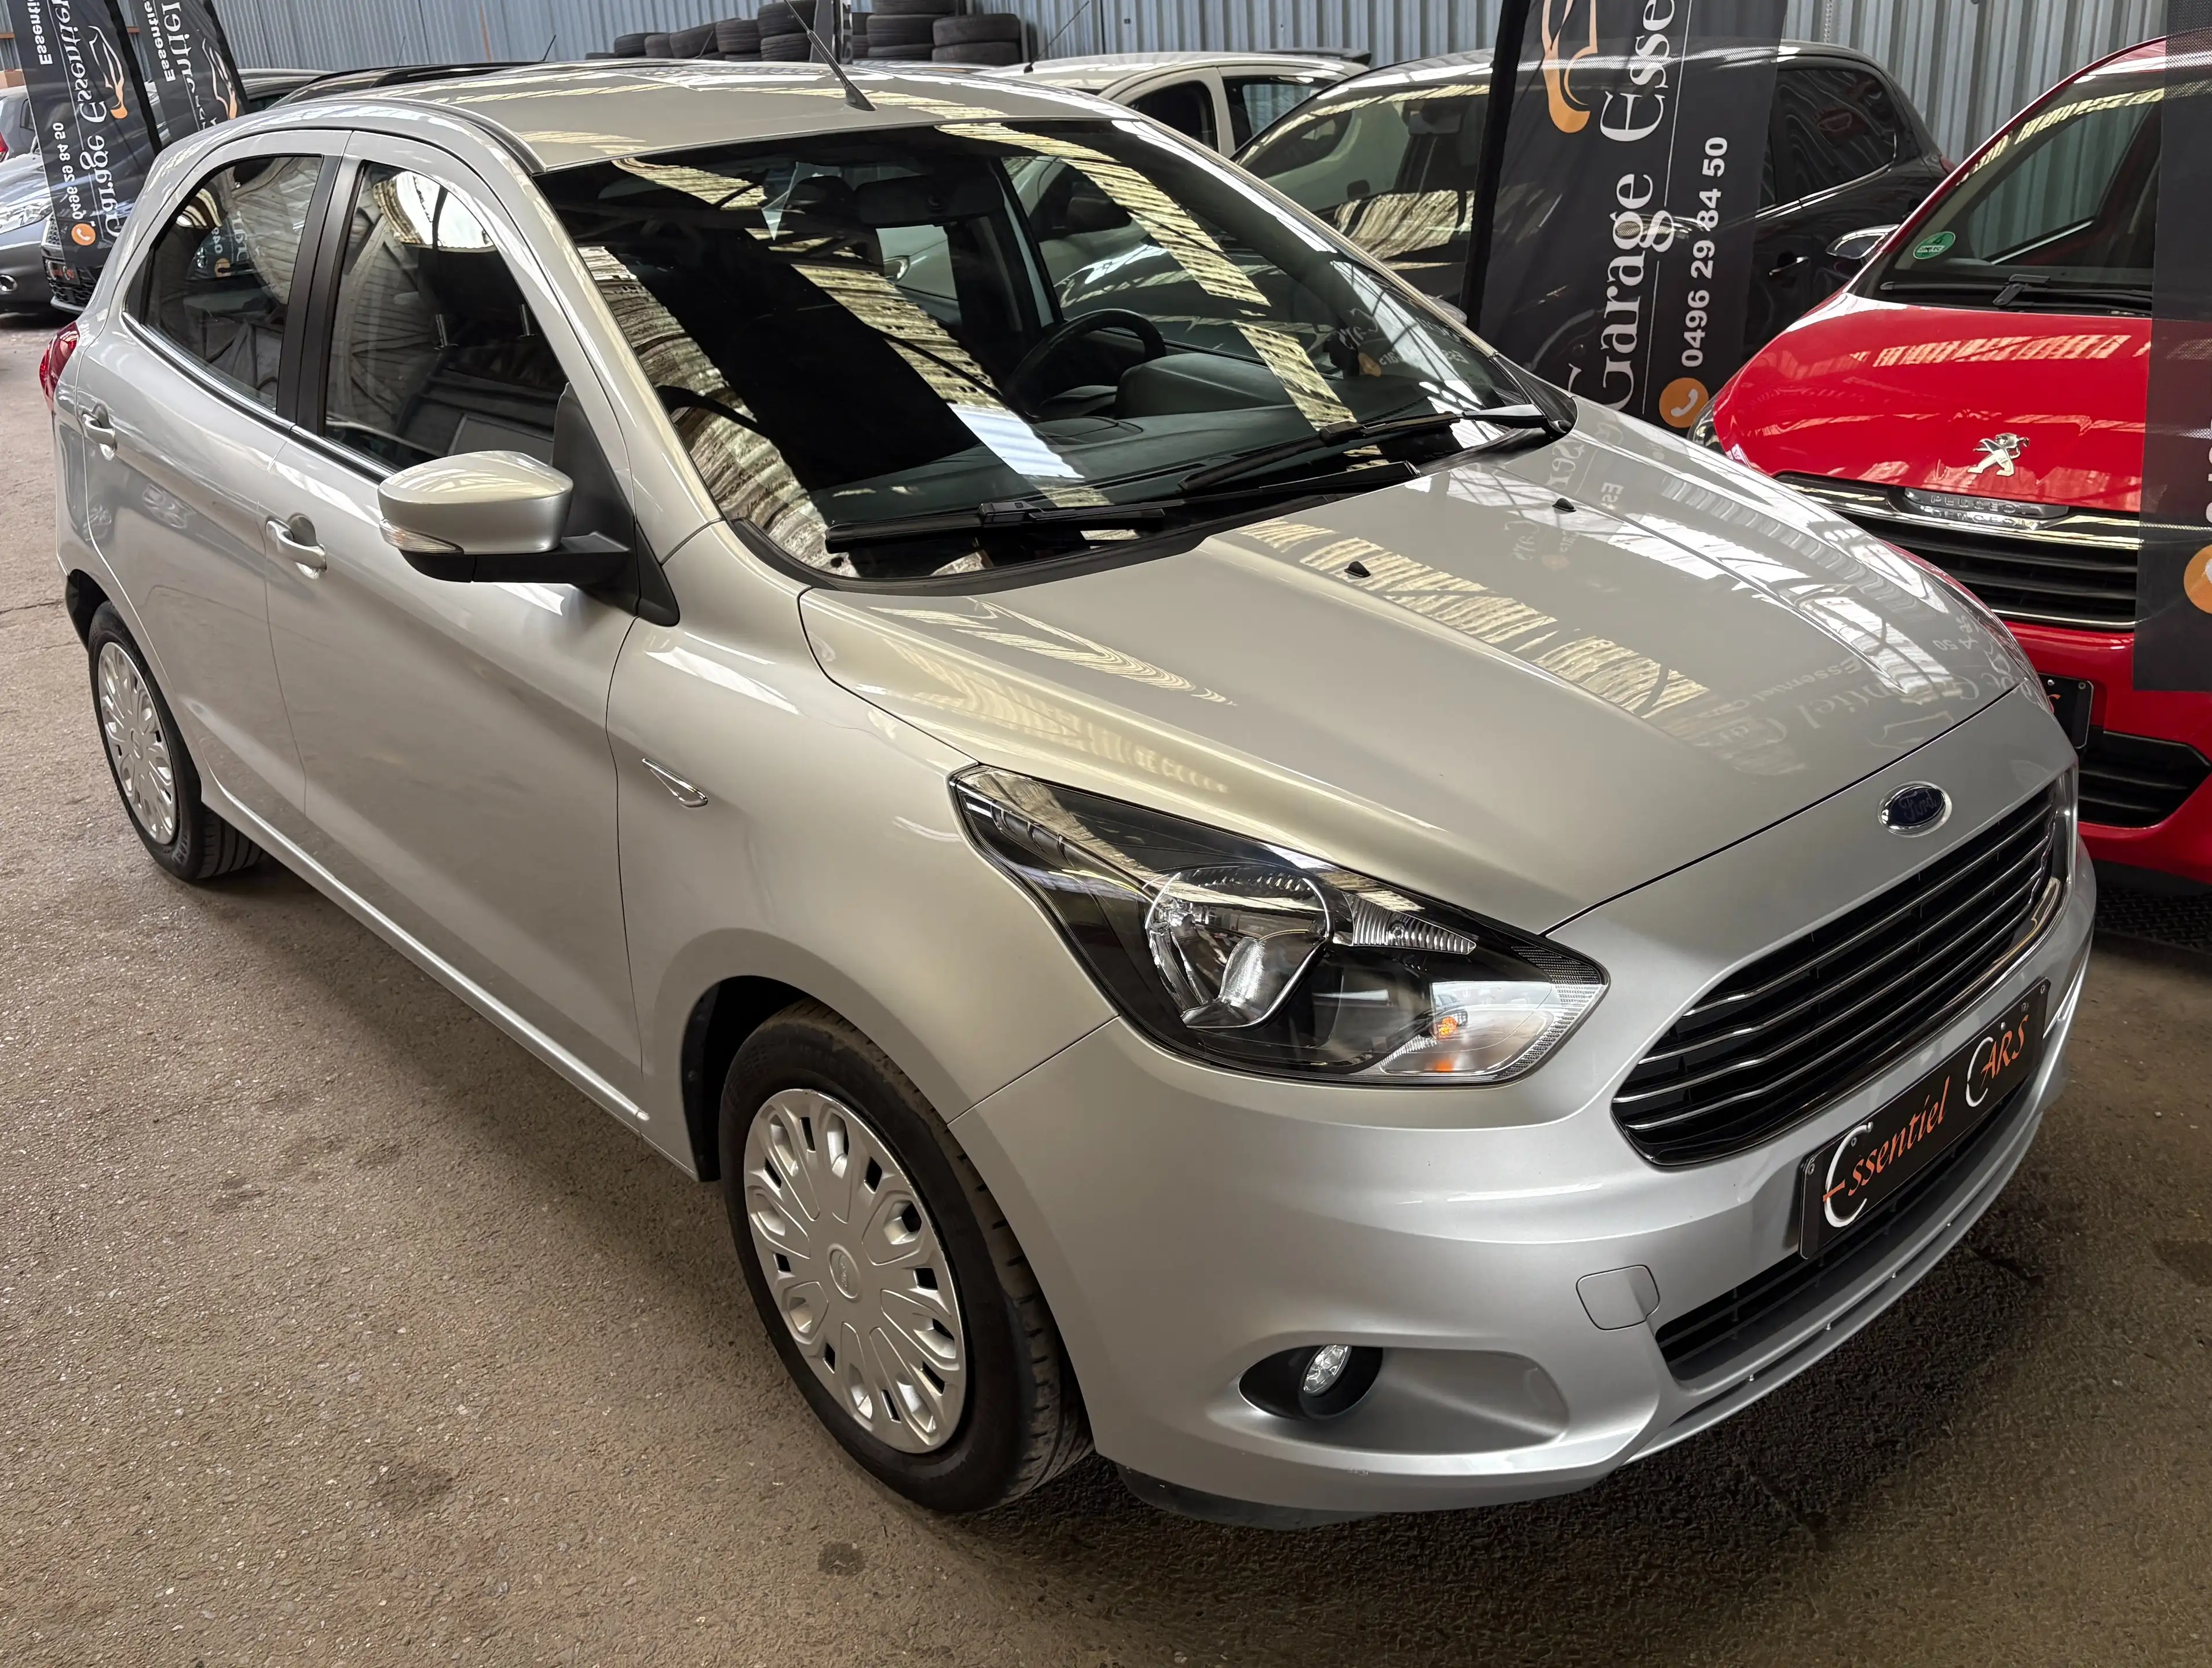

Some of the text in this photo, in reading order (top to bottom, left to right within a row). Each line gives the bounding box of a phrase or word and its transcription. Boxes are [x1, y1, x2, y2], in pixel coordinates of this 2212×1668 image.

[1600, 0, 1675, 411] Garage Esse
[1681, 137, 1728, 368] 0496 29 84 50
[1822, 1075, 1950, 1228] Essentiel
